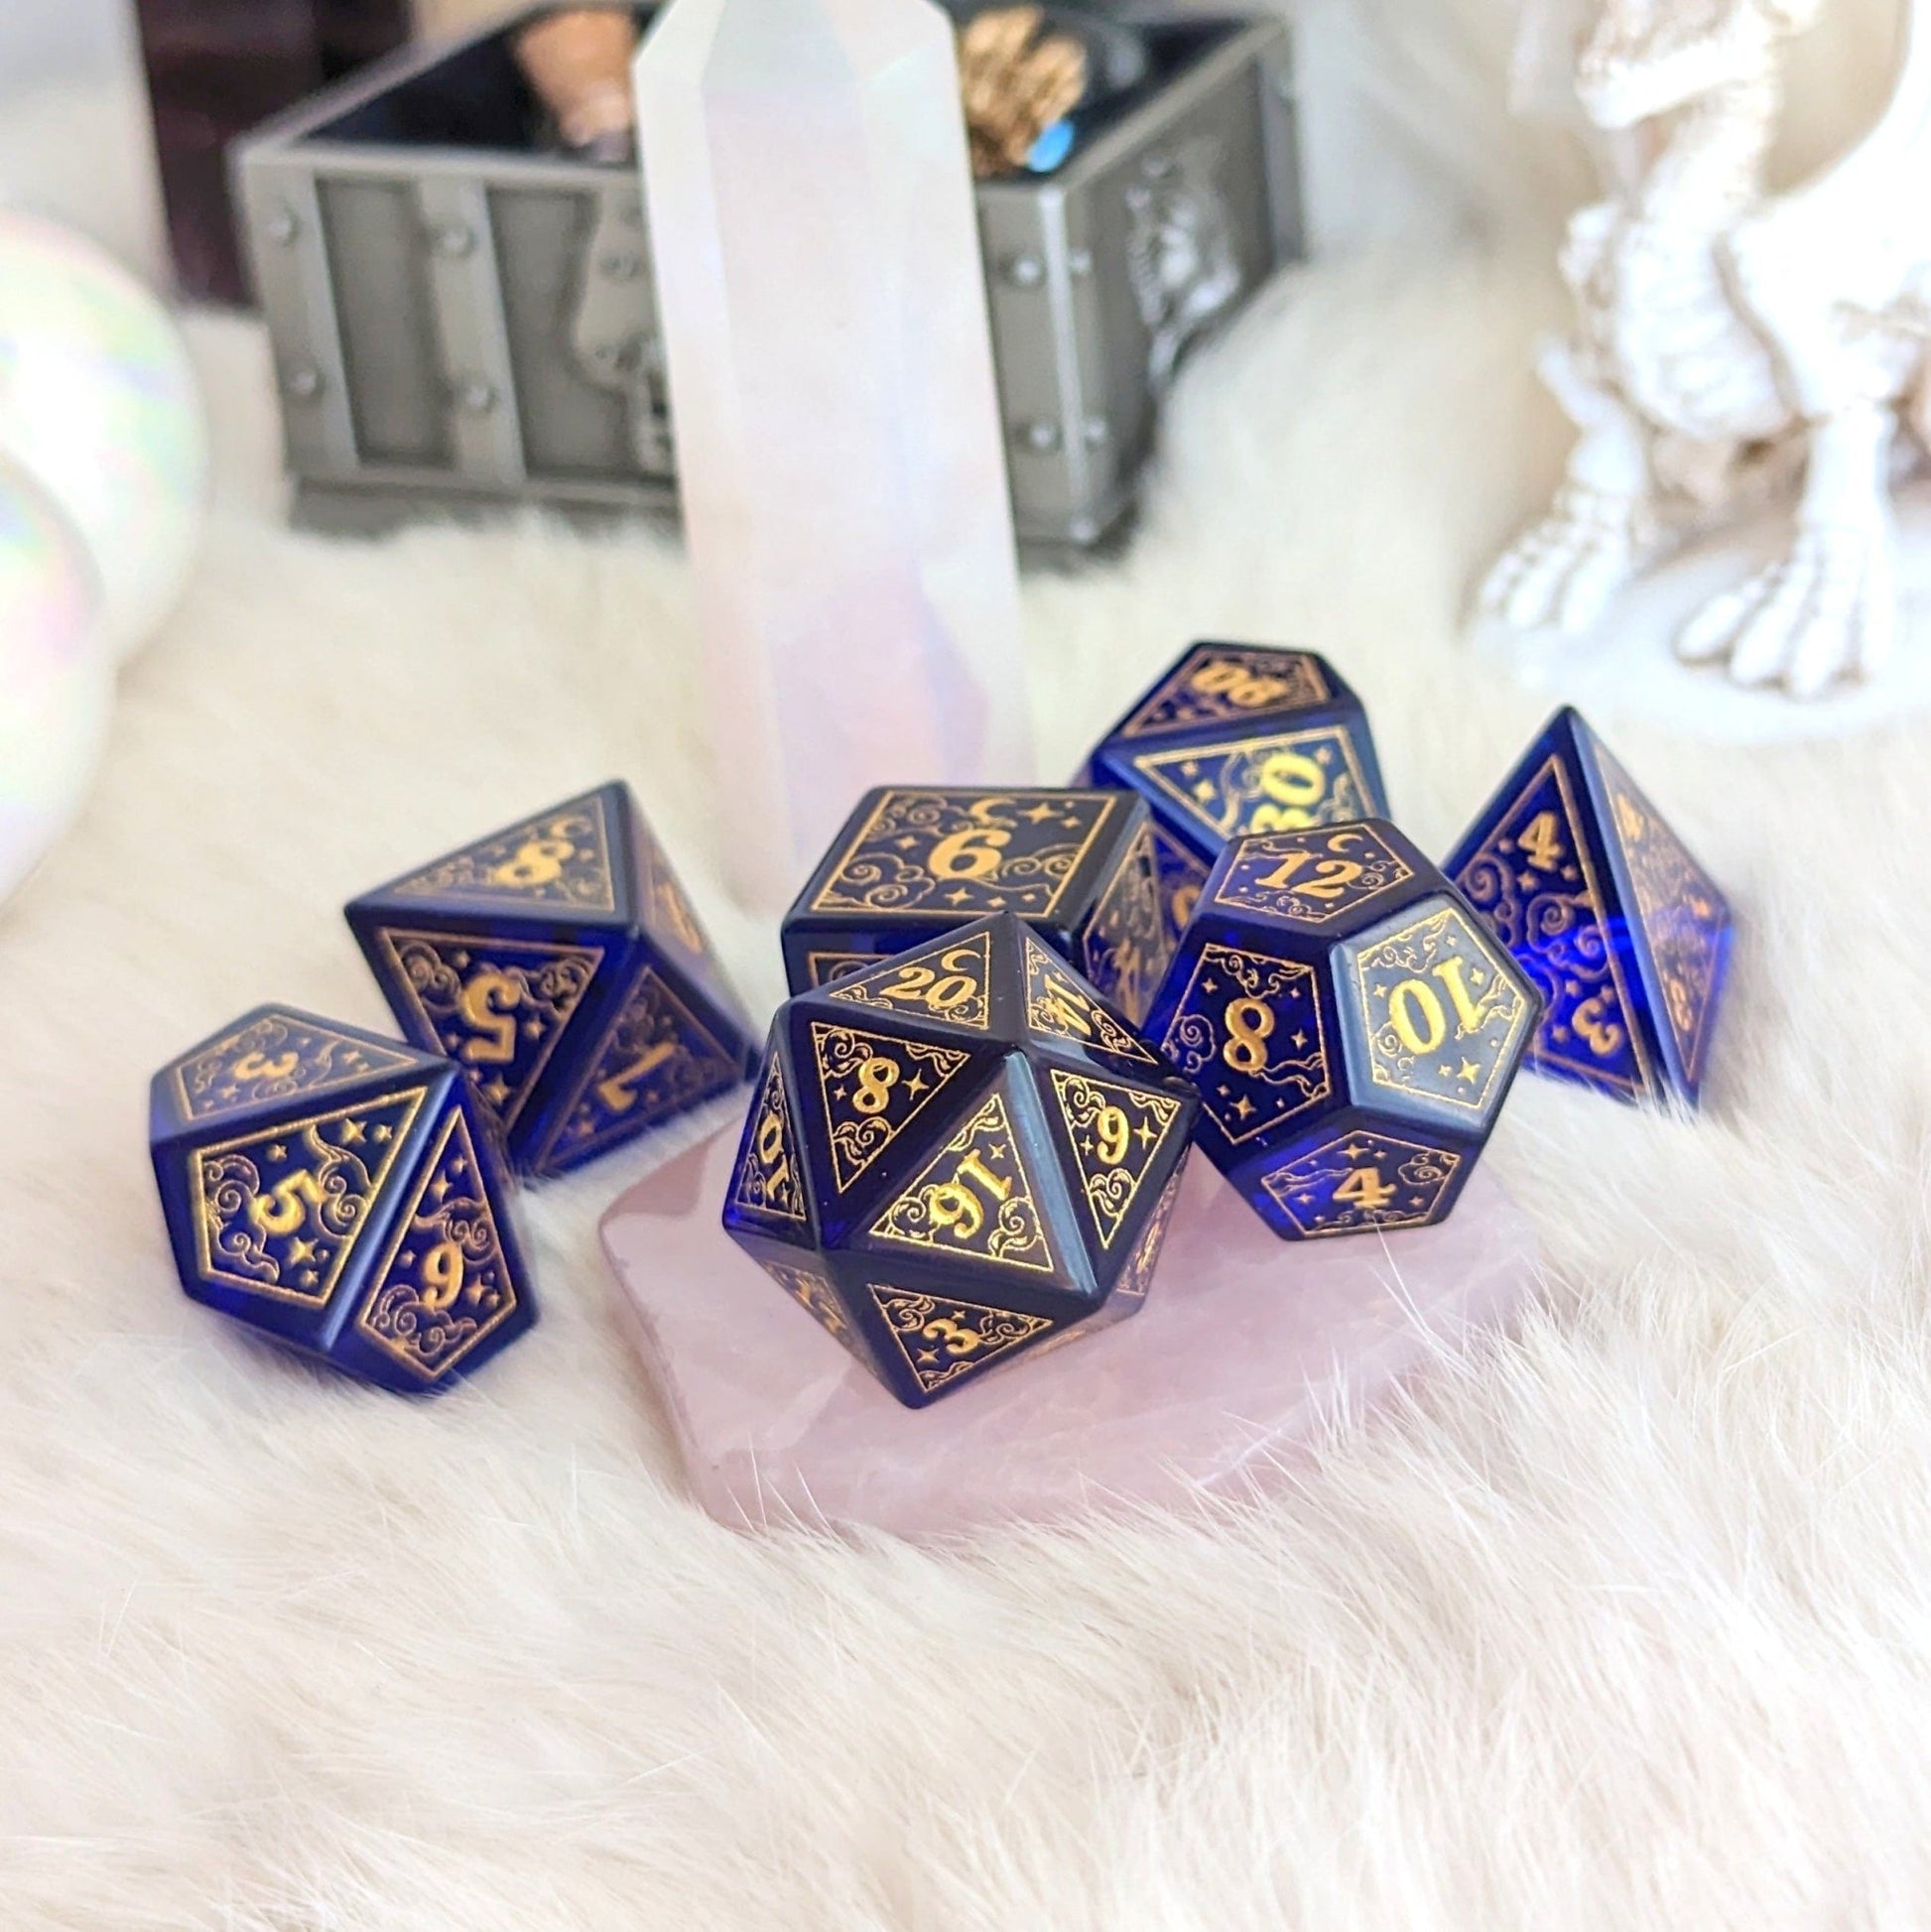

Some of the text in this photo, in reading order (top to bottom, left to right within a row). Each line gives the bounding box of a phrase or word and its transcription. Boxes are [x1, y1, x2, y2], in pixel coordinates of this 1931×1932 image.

[493, 839, 575, 888] 8
[928, 829, 1008, 881] 6
[1517, 810, 1565, 871] 4
[1254, 849, 1361, 901] 12
[879, 966, 976, 1008] 20
[1389, 955, 1484, 1057] 10
[459, 968, 522, 1063] 5
[1223, 996, 1275, 1074] 8
[1572, 997, 1621, 1057] 3
[233, 1051, 297, 1080] 3
[853, 1057, 900, 1113] 8
[250, 1168, 324, 1233] 5
[1331, 1166, 1397, 1211] 4
[420, 1241, 463, 1311] 9
[923, 1318, 980, 1353] 3
